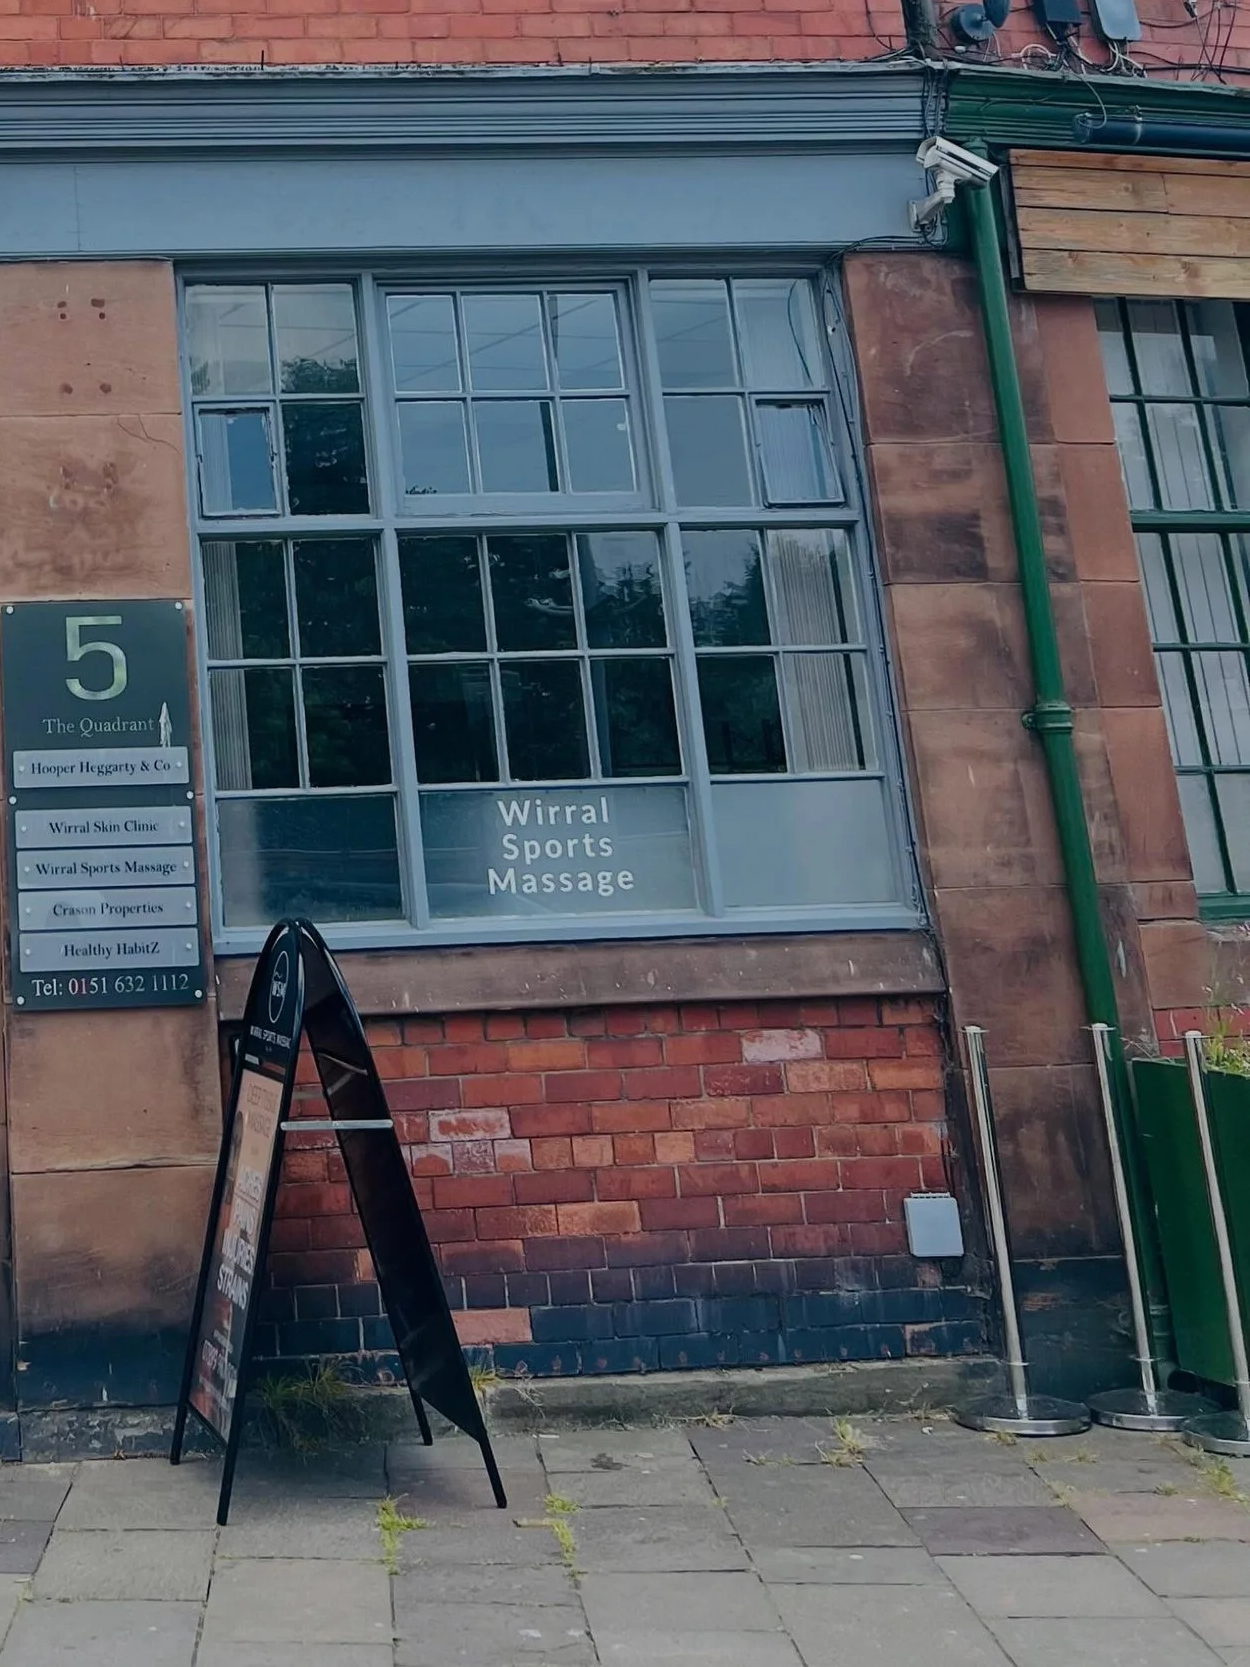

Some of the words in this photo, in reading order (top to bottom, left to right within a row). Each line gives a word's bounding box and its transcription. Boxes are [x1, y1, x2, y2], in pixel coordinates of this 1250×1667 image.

[66, 615, 128, 701] 5
[43, 718, 75, 734] The
[80, 716, 155, 737] Quadrant
[31, 762, 76, 777] Hooper
[79, 761, 136, 776] Heggarty
[140, 761, 150, 772] &
[154, 759, 171, 772] Co
[497, 796, 609, 827] Wirral
[49, 821, 90, 834] Wirral
[93, 820, 121, 833] Skin
[124, 820, 159, 832] Clinic
[502, 833, 613, 865] Sports
[36, 862, 77, 875] Wirral
[80, 861, 121, 877] Sports
[125, 860, 177, 875] Massage
[488, 868, 634, 897] Massage
[53, 904, 96, 917] Crason
[101, 902, 164, 919] Properties
[64, 944, 112, 959] Healthy
[117, 942, 160, 955] HabitZ
[32, 979, 62, 996] Tel:
[69, 977, 108, 995] 0151
[114, 975, 145, 993] 632
[152, 974, 189, 991] 1112
